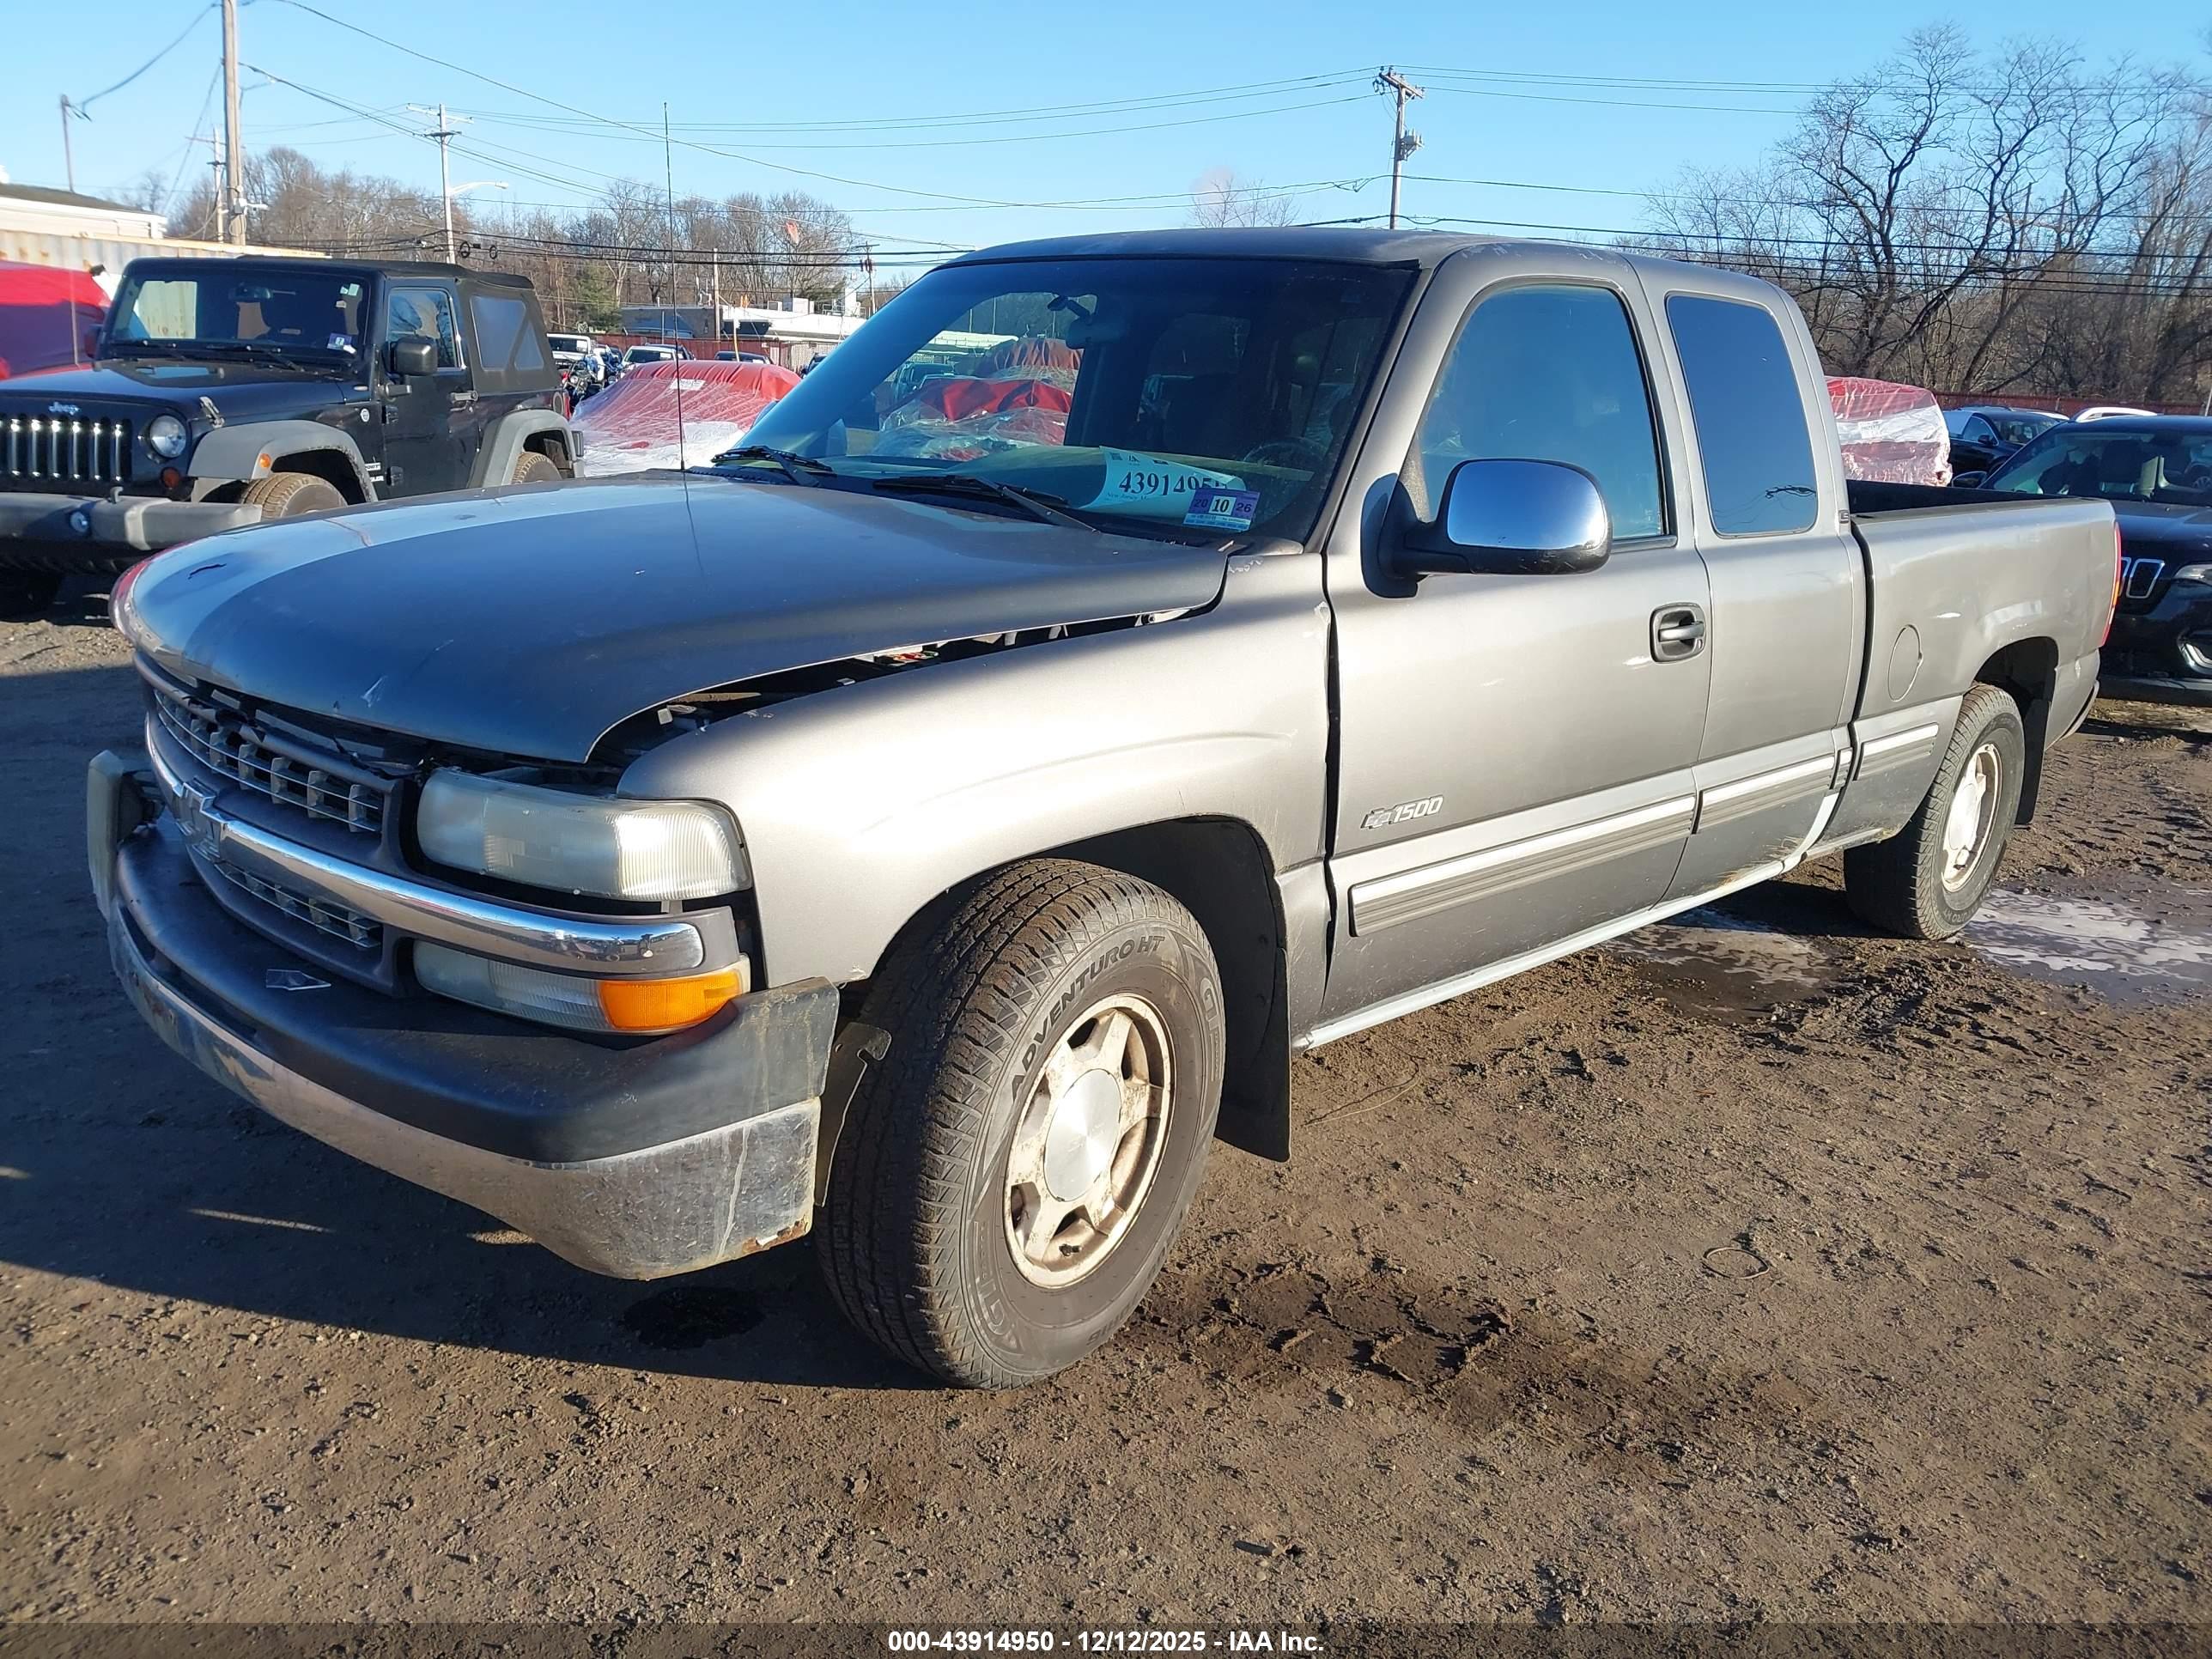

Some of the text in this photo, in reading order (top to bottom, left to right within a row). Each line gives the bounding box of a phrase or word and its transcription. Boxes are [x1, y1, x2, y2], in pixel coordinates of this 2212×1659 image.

[48, 401, 80, 416] Jeep
[1194, 498, 1252, 513] 20 10 26
[1394, 794, 1444, 823] 1500
[1012, 935, 1165, 1103] ADVENTURO HT
